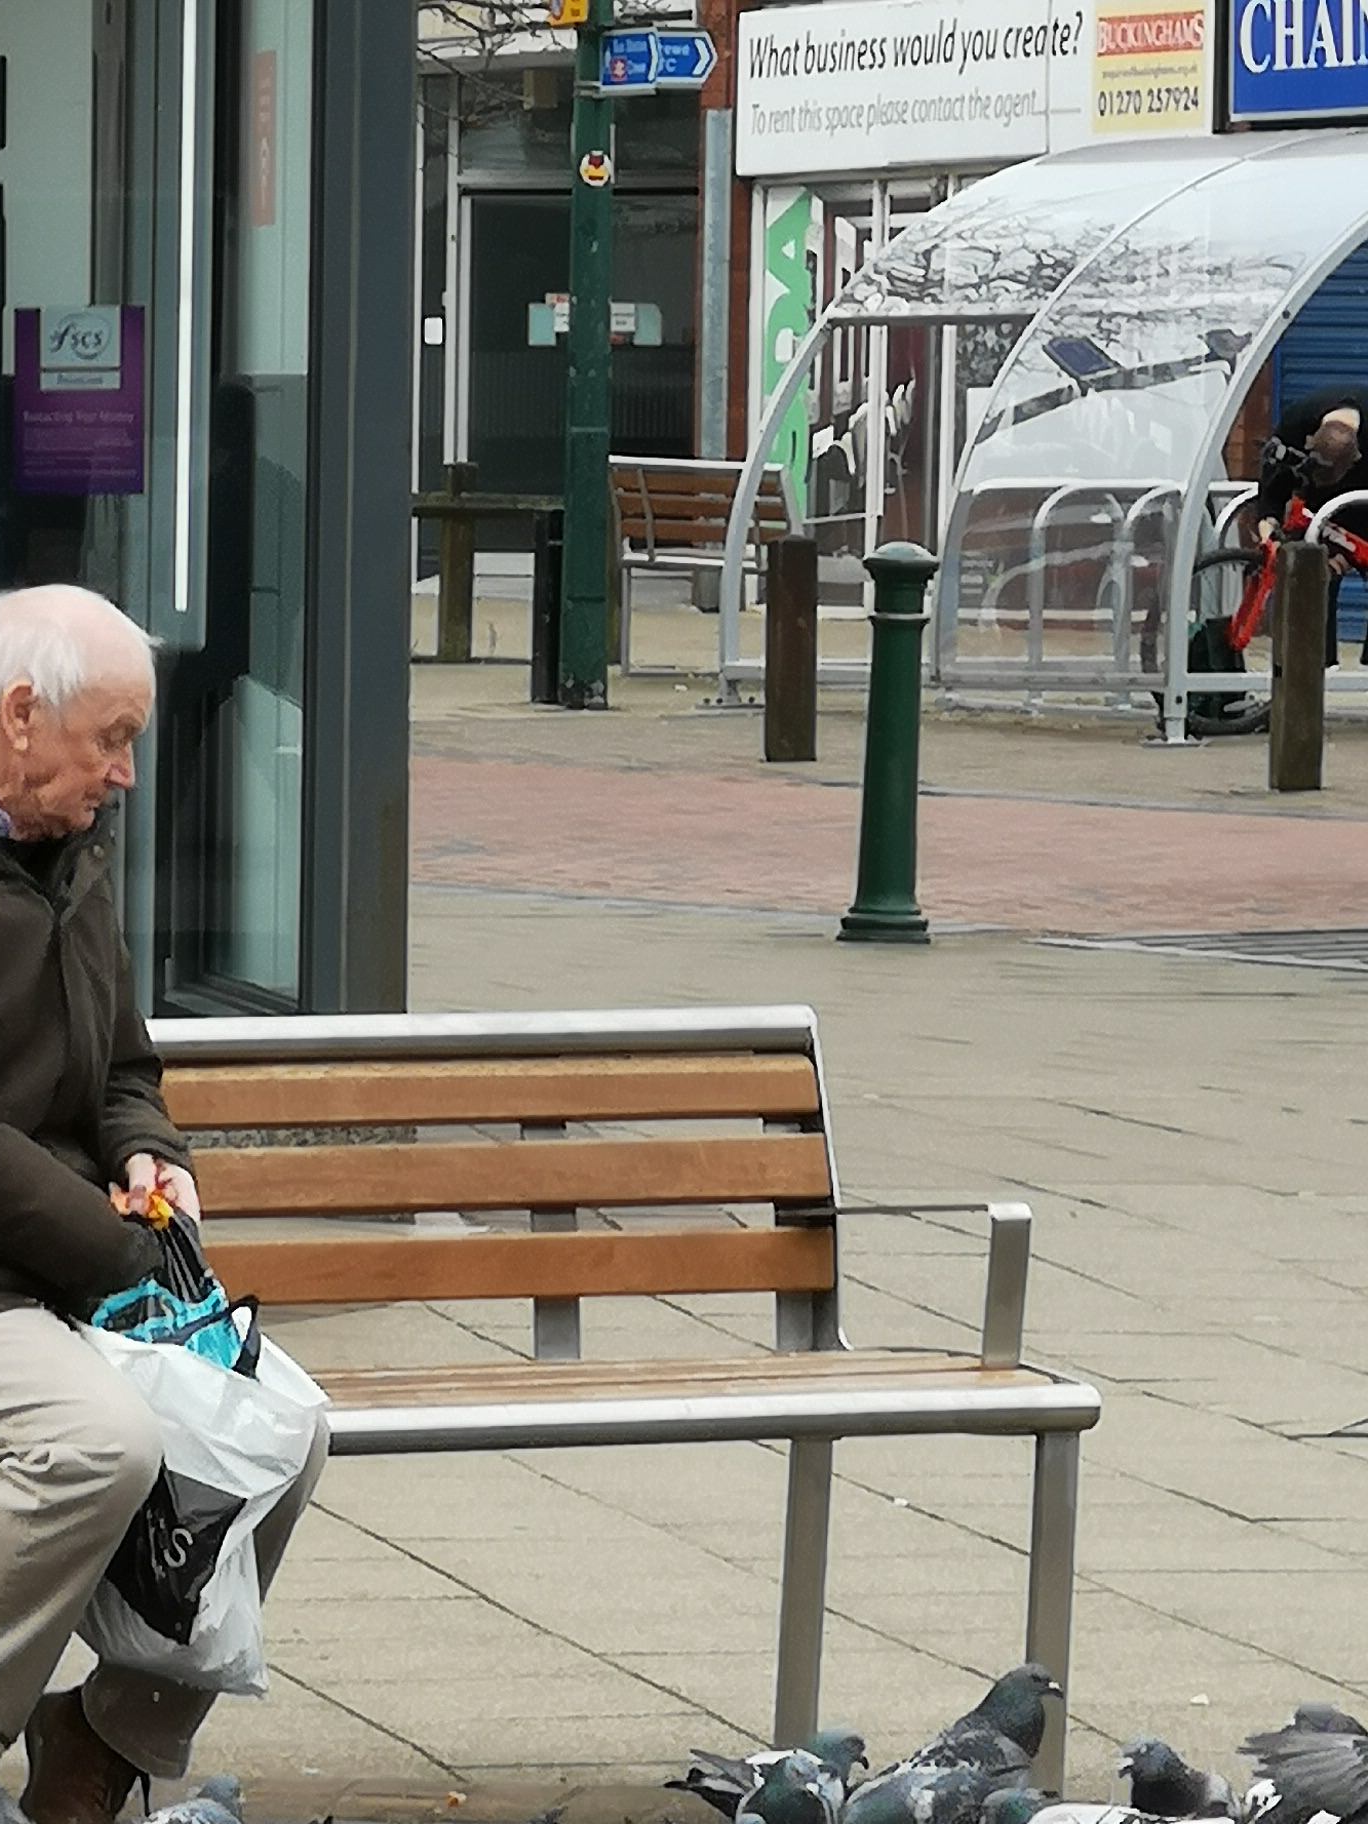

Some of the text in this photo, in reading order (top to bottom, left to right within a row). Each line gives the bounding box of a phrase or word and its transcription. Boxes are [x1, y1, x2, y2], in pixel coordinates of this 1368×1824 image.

[749, 11, 1083, 79] What business would you create?
[1097, 13, 1205, 54] BUCKINGHAMS
[751, 103, 766, 136] To
[768, 101, 797, 134] rent
[797, 99, 823, 132] this
[824, 103, 864, 138] space
[866, 92, 909, 136] please
[911, 92, 966, 124] contact
[966, 87, 992, 120] the
[1098, 85, 1200, 117] 01270 257924
